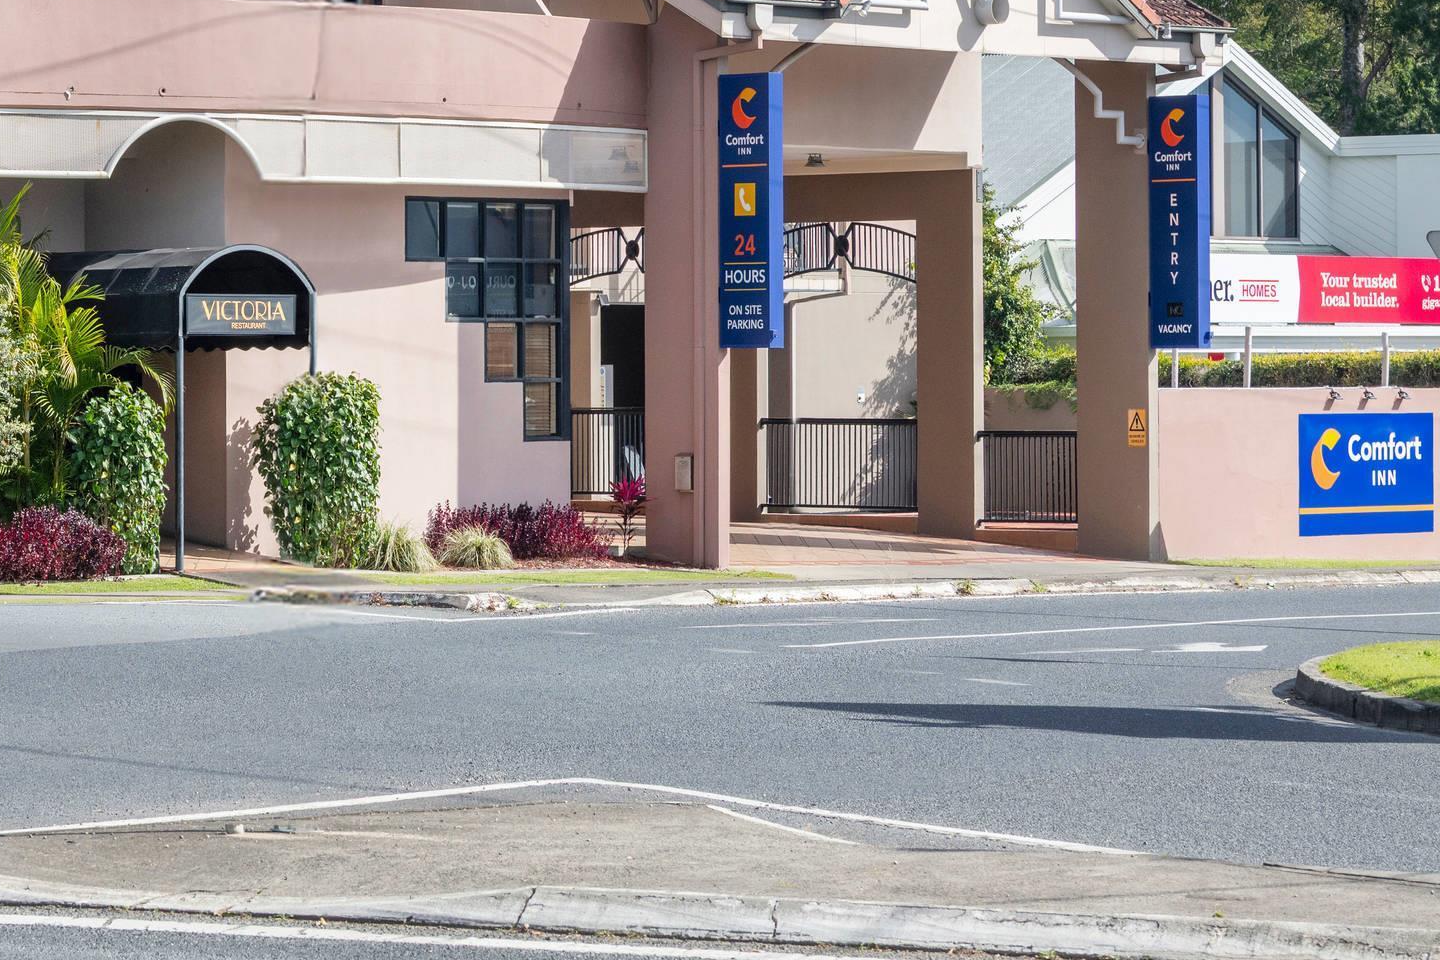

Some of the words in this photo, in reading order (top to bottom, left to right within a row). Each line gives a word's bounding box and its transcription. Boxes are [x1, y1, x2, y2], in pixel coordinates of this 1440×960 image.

[725, 132, 764, 146] Comfort
[737, 147, 752, 155] INN
[1154, 150, 1192, 162] Comfort
[1166, 163, 1180, 171] INN
[734, 234, 756, 256] 24
[1169, 193, 1179, 285] ENTRY
[725, 269, 766, 284] HOURS
[1320, 272, 1350, 288] Your
[1352, 273, 1397, 289] trusted
[1242, 284, 1277, 297] HOMES
[1320, 291, 1351, 307] local
[1353, 292, 1399, 308] builder.
[202, 300, 286, 321] VICTORIA
[728, 305, 742, 316] ON
[744, 304, 762, 315] SITE
[727, 319, 764, 330] PARKING
[1158, 324, 1192, 334] VACANCY
[1348, 432, 1422, 462] Comfort
[1372, 469, 1397, 486] INN
